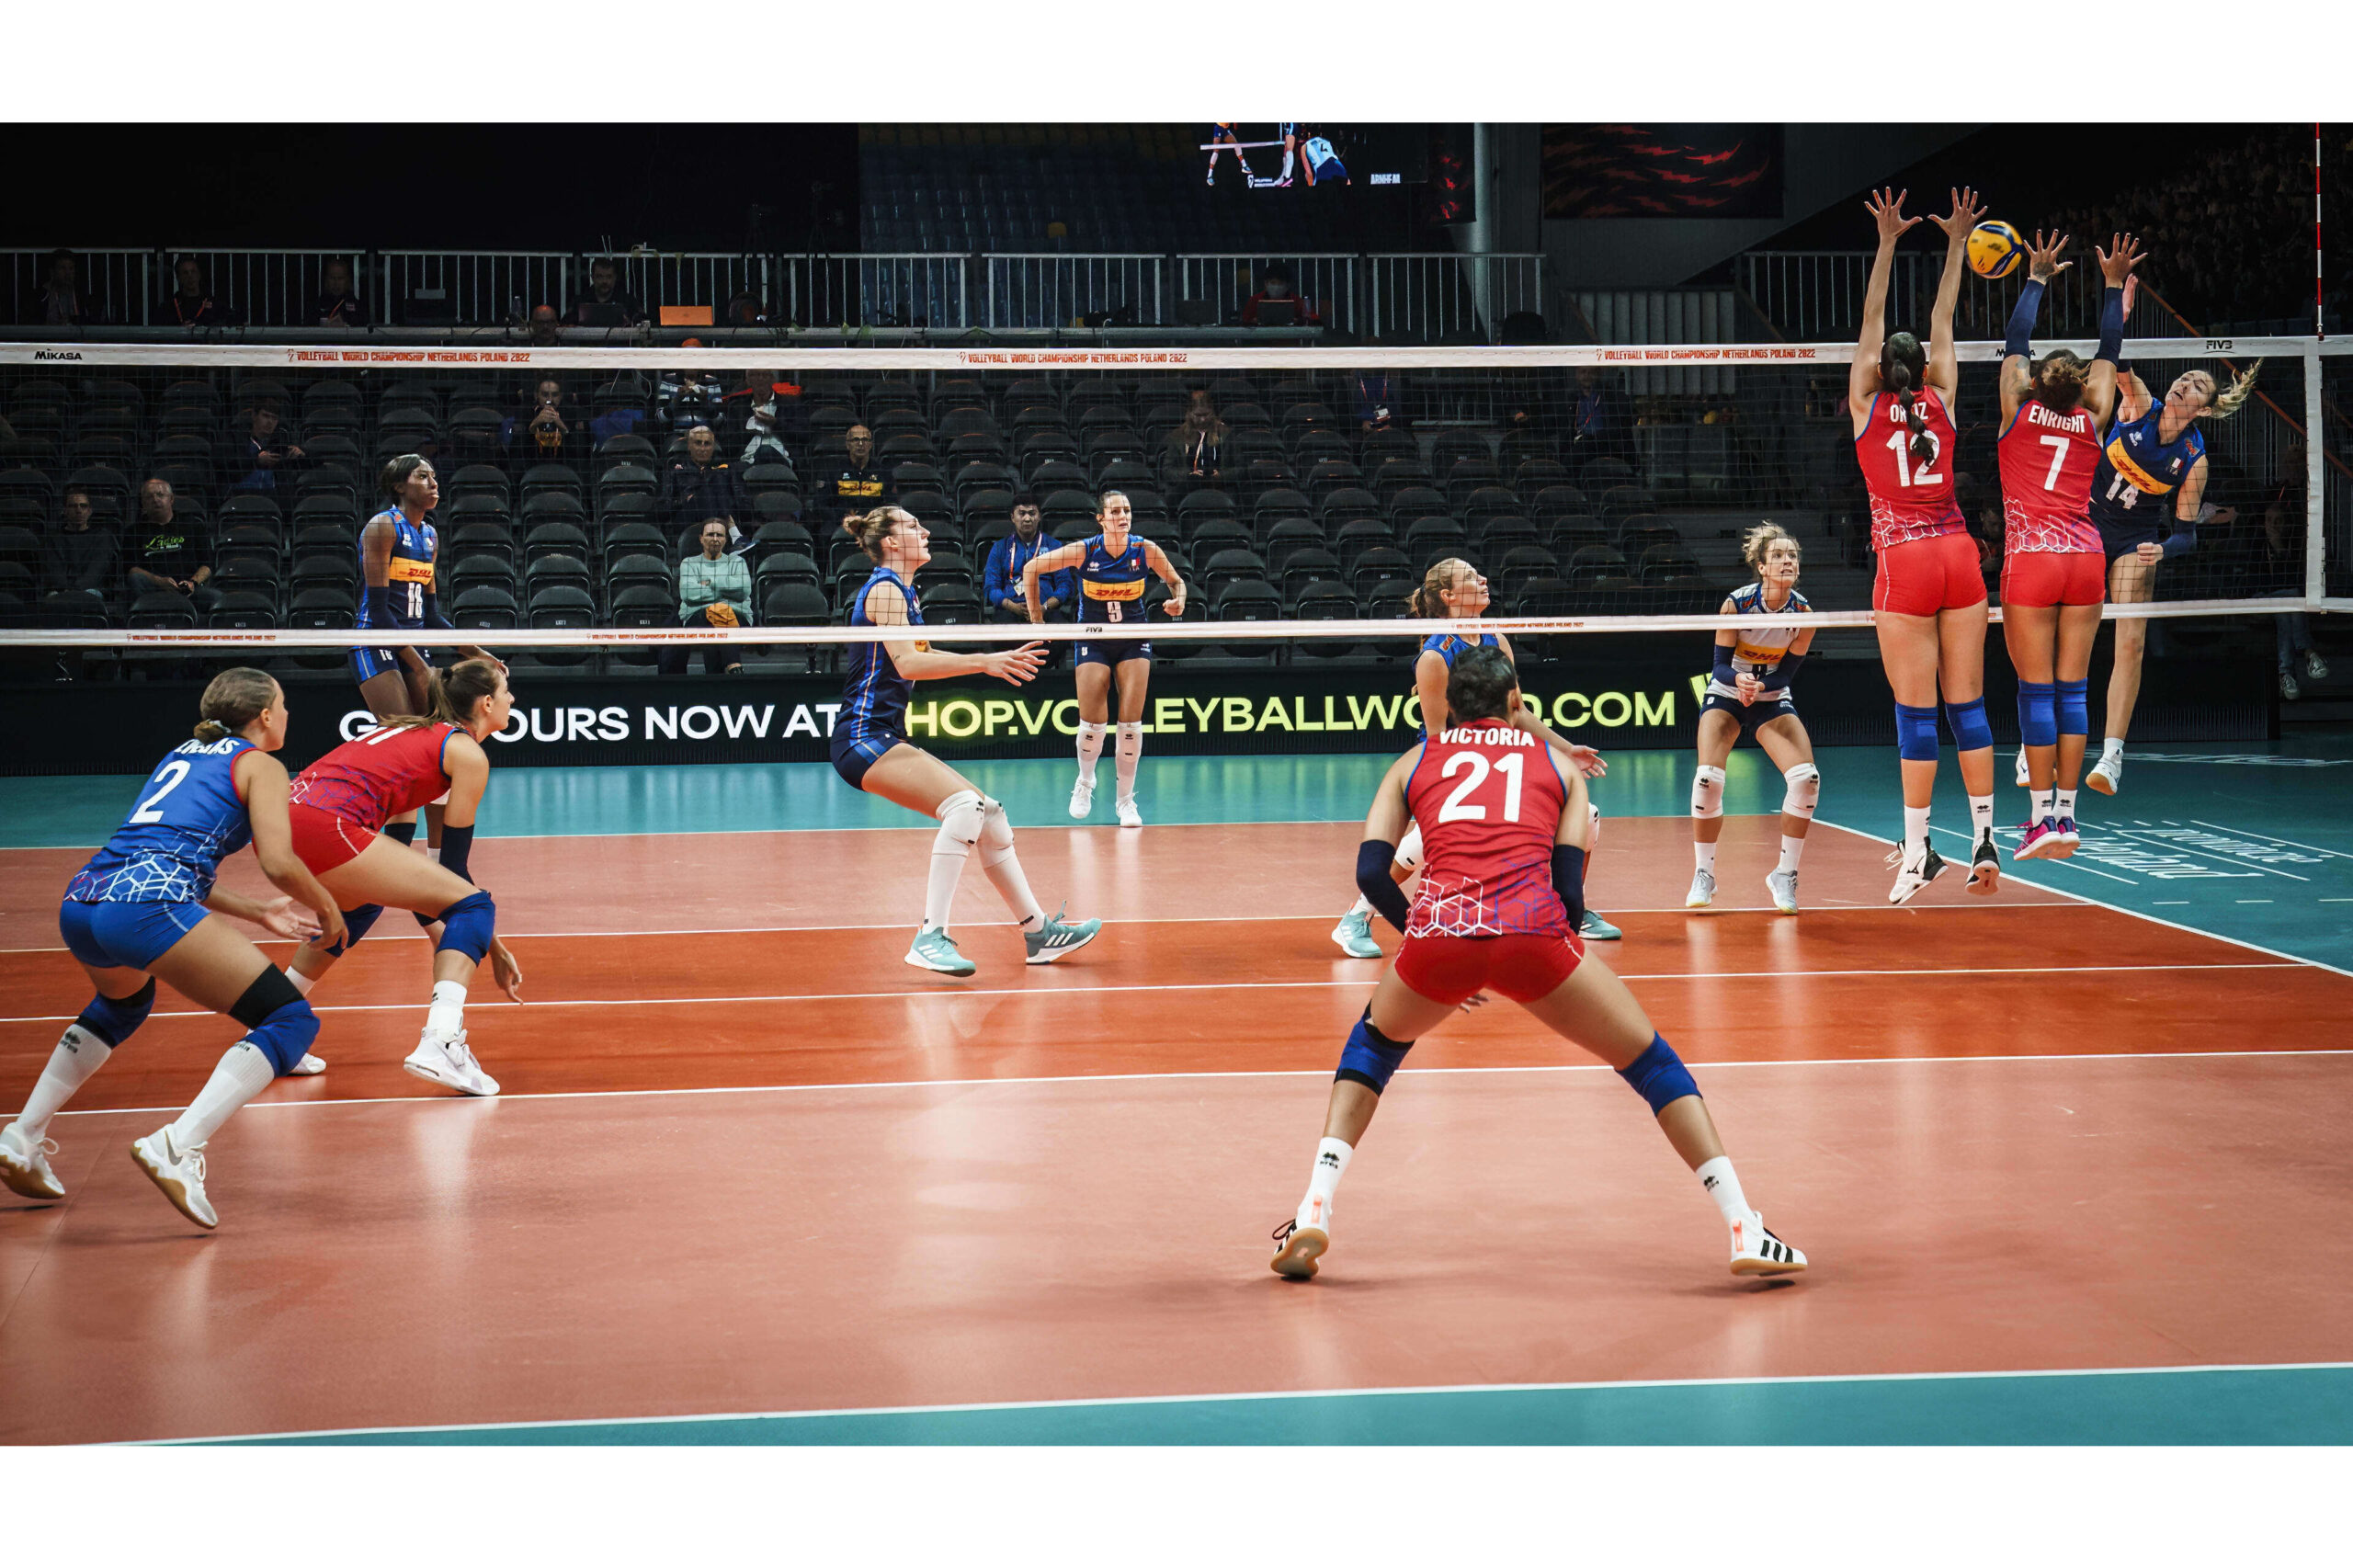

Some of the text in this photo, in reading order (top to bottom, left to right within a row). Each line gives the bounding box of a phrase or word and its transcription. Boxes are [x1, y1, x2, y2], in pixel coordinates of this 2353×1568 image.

[34, 348, 83, 360] MIKASA
[1604, 348, 1816, 360] VOLLEYBALL WORLD CHAMPIONSHIP NETHERLANDS POLAND 2022
[2206, 340, 2234, 350] FIVB
[297, 351, 530, 362] VOLLEYBALL WORLD CHAMPIONSHIP NETHERLANDS POLAND 2022
[968, 353, 1188, 363] VOLLEYBALL WORLD CHAMPIONSHIP NETHERLANDS POLAND 2022
[1890, 402, 1929, 423] ORIZ
[2028, 404, 2086, 434] ENRIGHT
[1886, 430, 1943, 487] 12
[2040, 435, 2070, 491] 7
[2116, 459, 2152, 487] DHL
[2106, 472, 2139, 510] 14
[1107, 601, 1123, 623] 9
[1743, 649, 1781, 661] DHL
[491, 691, 1676, 743] OURS NOW AT HOP.VOEYBALLWOD.COM
[1439, 727, 1535, 747] VICTORIA
[129, 759, 191, 824] 2
[1438, 751, 1523, 824] 21
